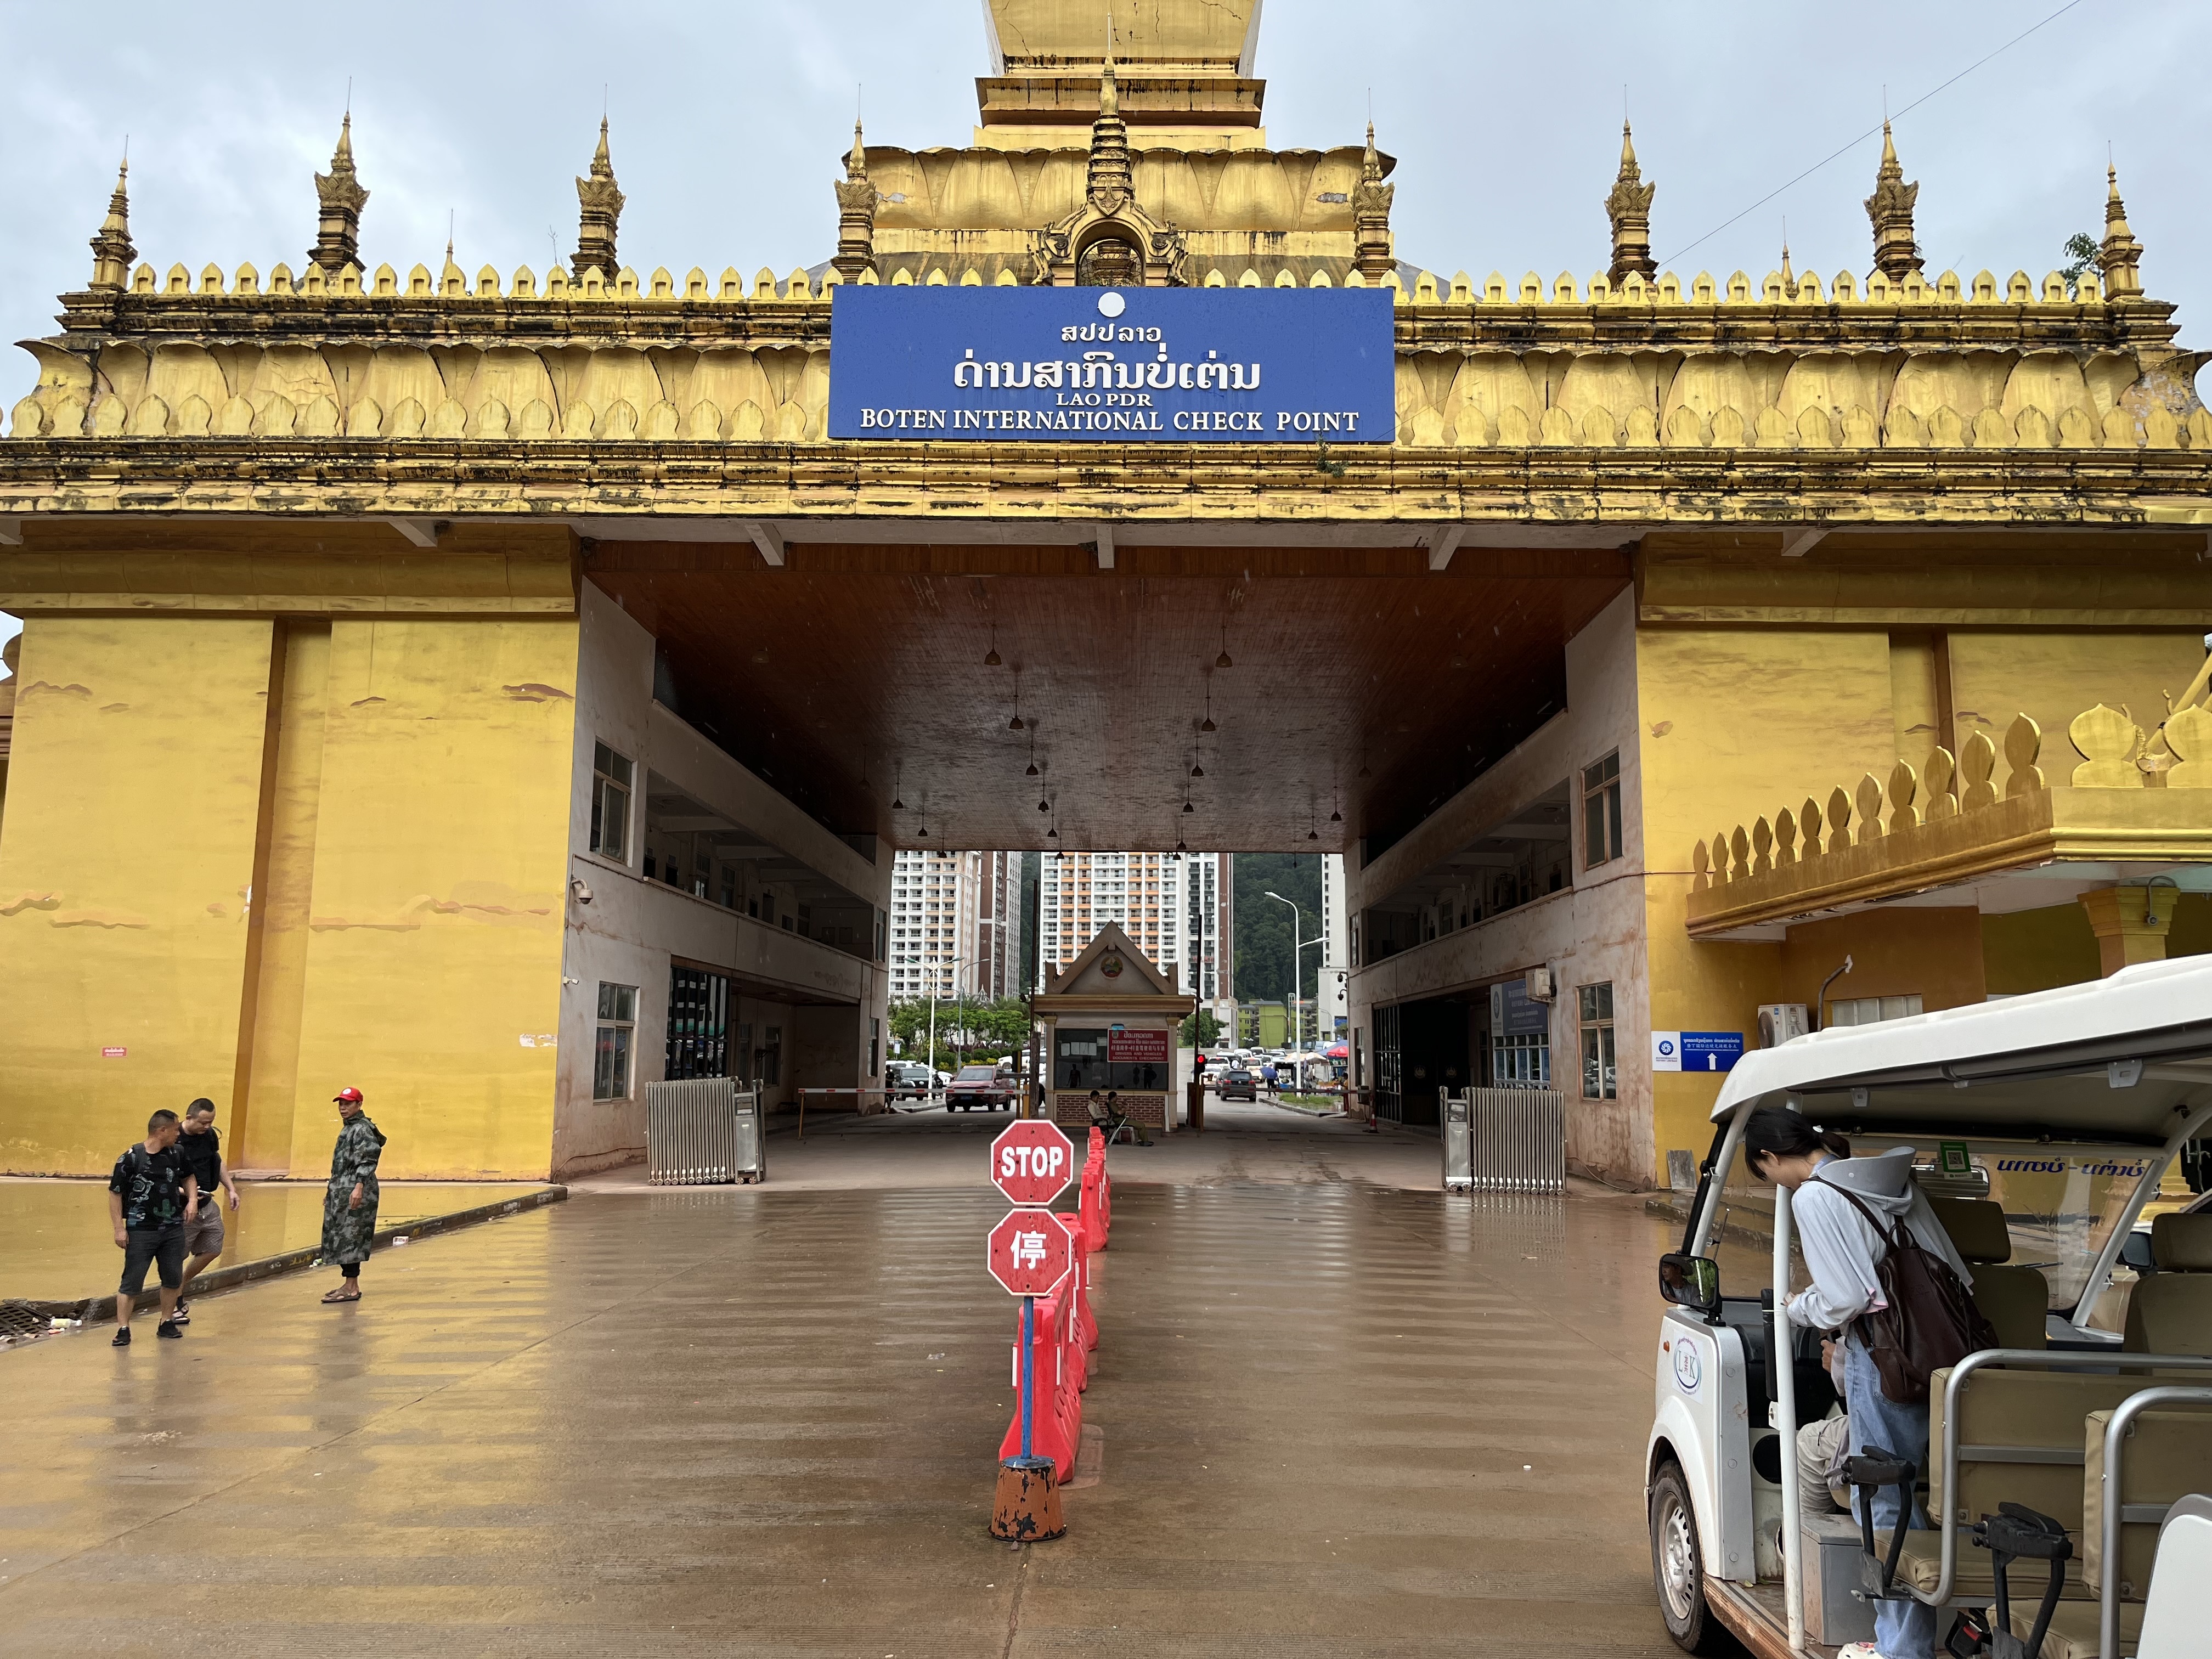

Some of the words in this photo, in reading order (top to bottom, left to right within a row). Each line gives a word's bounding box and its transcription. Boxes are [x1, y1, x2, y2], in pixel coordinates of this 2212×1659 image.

[1056, 393, 1101, 407] LAO
[1105, 393, 1153, 407] PDR
[860, 409, 946, 428] BOTEN
[953, 409, 1163, 431] INTERNATIONAL
[1173, 411, 1264, 431] CHECK
[1276, 411, 1359, 431] POINT
[1001, 1146, 1064, 1177] STOP
[1010, 1230, 1047, 1269] 停
